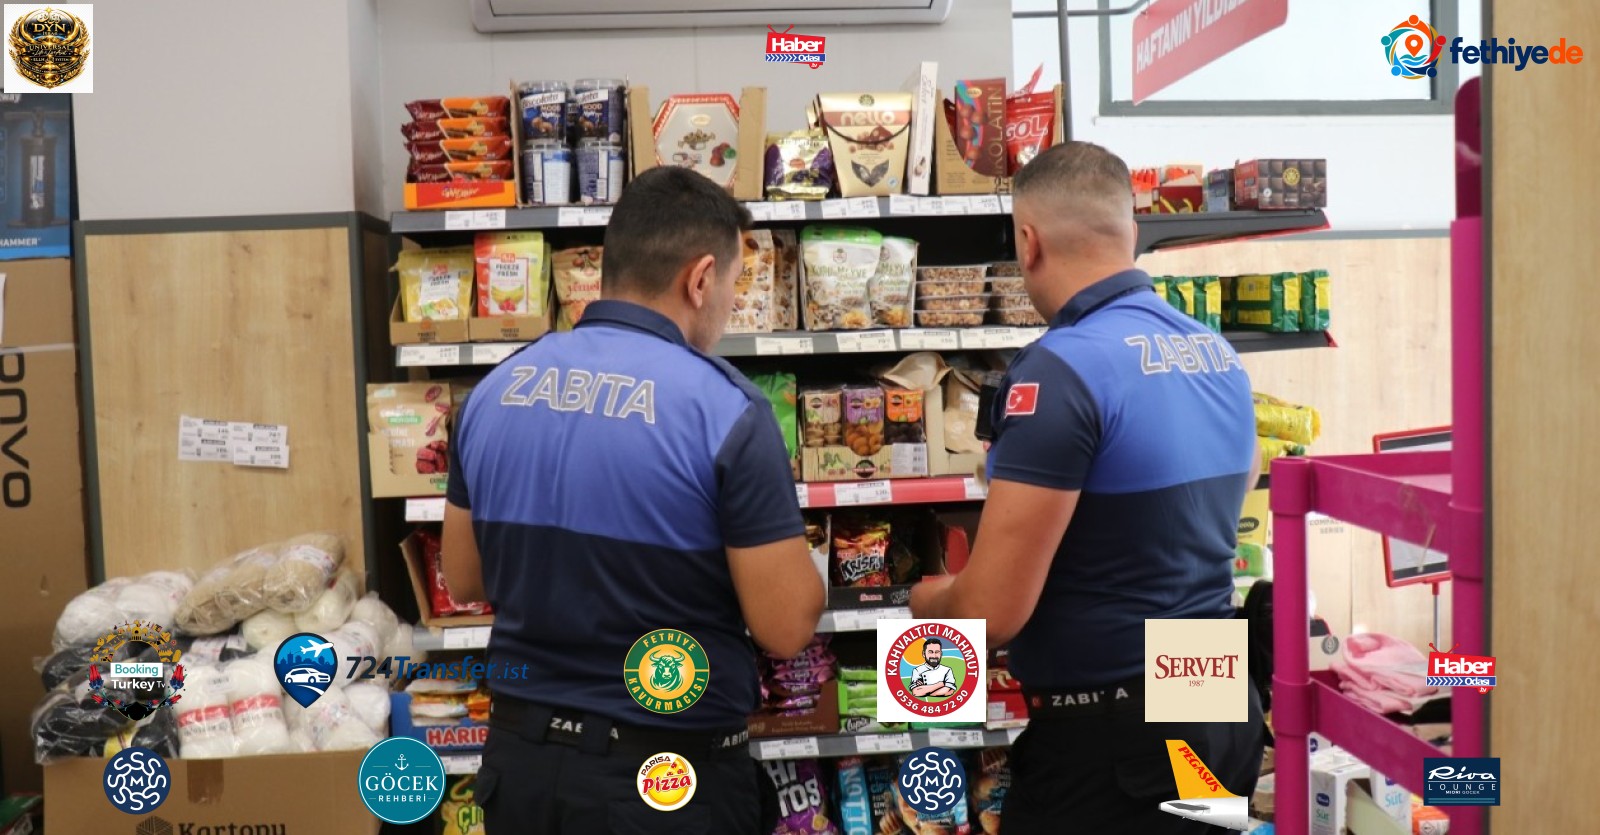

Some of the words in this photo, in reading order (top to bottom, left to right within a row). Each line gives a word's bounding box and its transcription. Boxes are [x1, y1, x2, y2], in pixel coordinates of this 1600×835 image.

[1137, 4, 1192, 75] HAFTANIN
[1124, 333, 1243, 375] ZABITA
[501, 366, 655, 424] ZABITA
[1051, 687, 1129, 707] ZABIA
